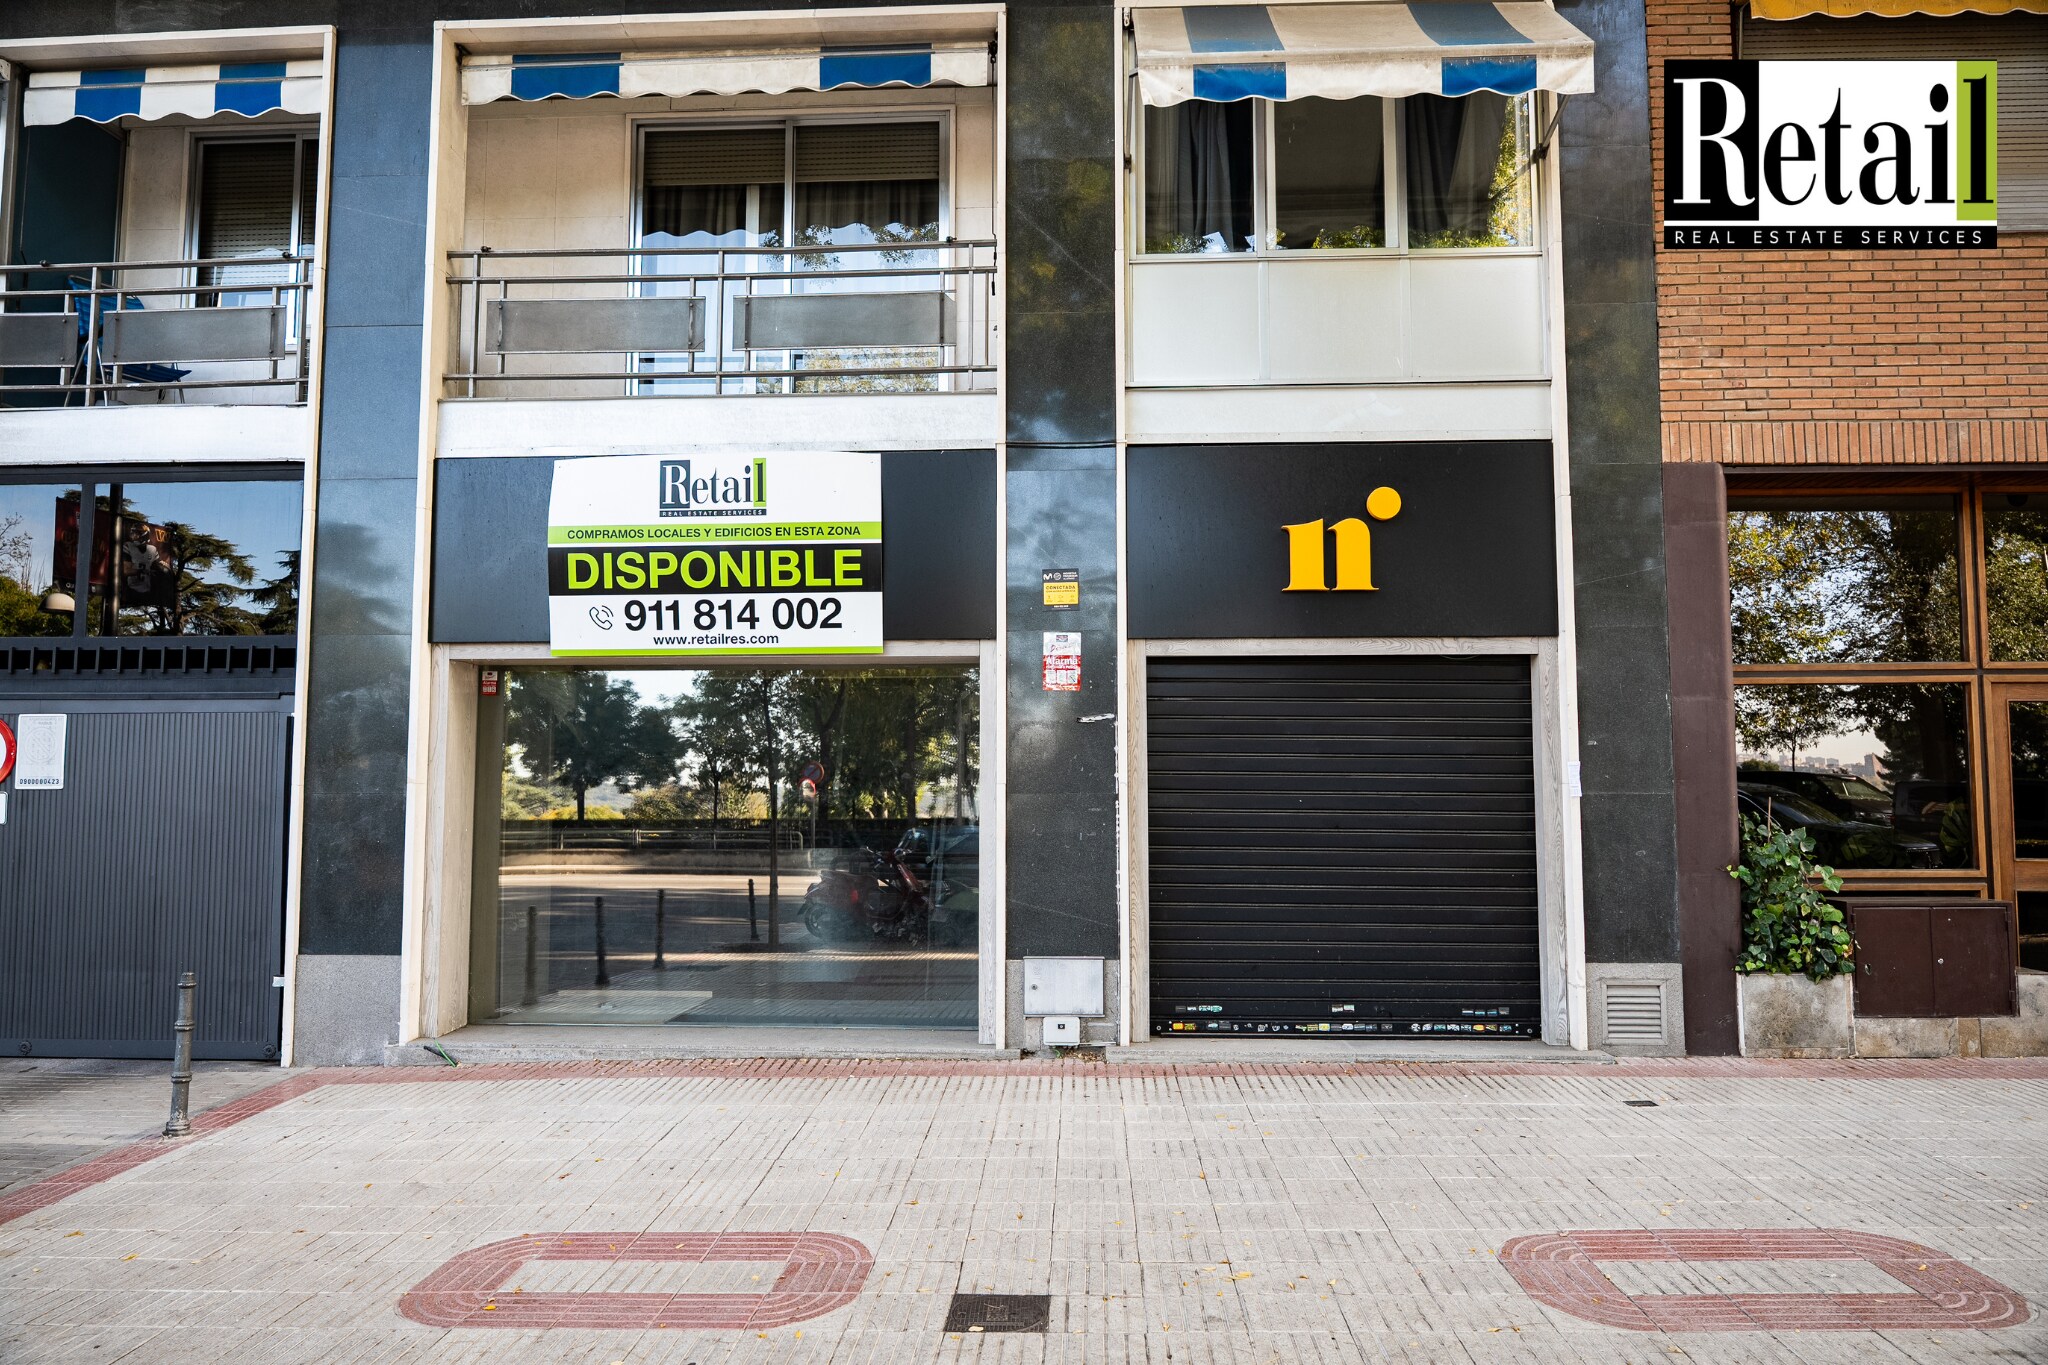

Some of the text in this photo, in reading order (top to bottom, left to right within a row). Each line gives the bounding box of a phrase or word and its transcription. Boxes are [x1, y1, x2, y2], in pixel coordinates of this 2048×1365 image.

[662, 462, 766, 505] Retail
[567, 526, 861, 540] COMPRAMOS LOCALES Y EDIFICIOS EN ESTA ZONA
[567, 549, 863, 590] DISPONIBLE
[624, 598, 843, 632] 911 814 002
[653, 633, 779, 646] www.retailres.com
